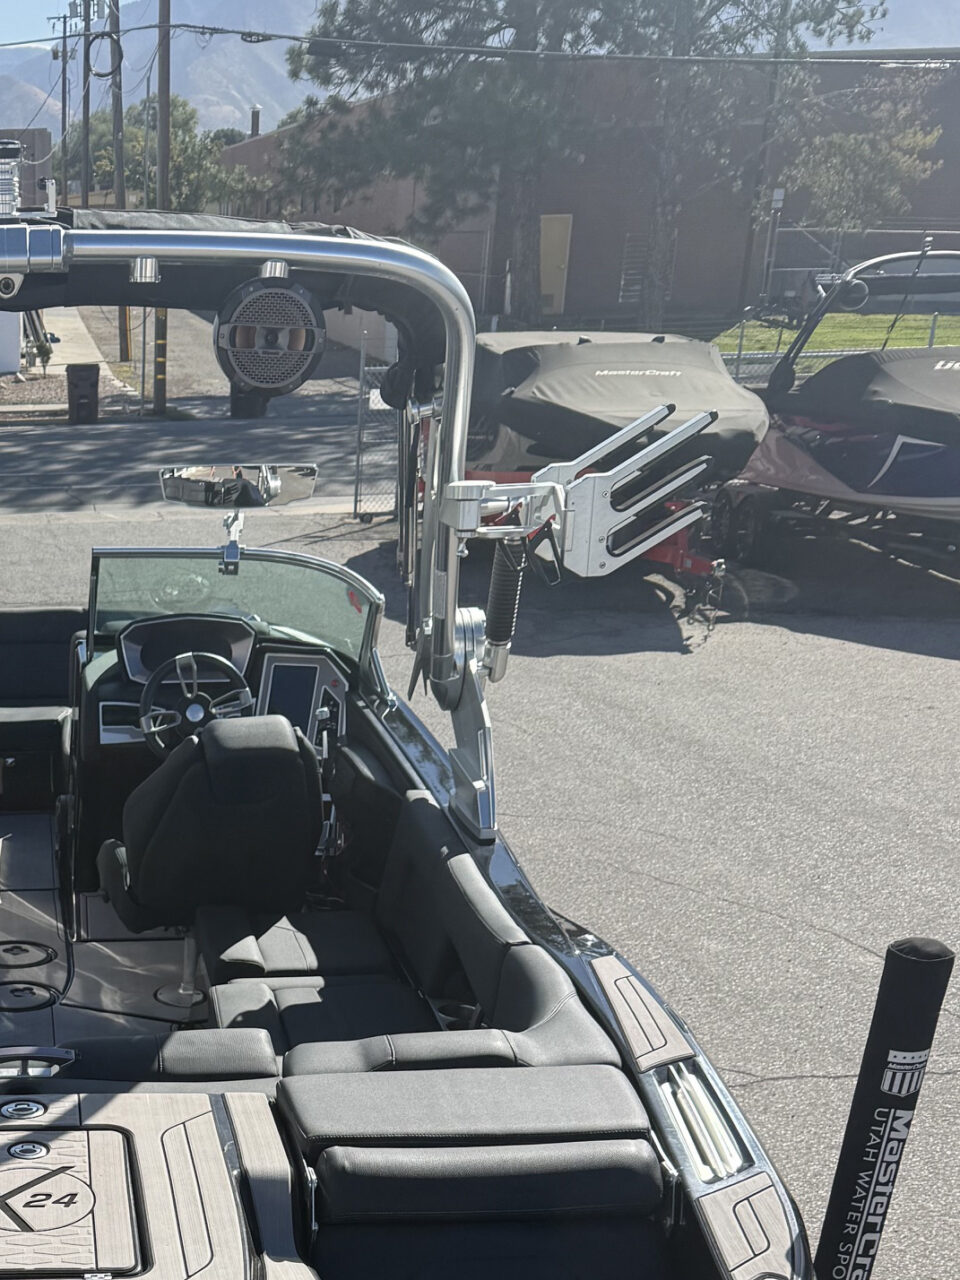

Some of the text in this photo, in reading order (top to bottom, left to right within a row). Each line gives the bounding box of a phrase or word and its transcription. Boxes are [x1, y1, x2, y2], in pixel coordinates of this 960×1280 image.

[595, 369, 682, 377] MasterCraft
[862, 1107, 889, 1162] UTAH
[843, 1170, 873, 1234] WATER
